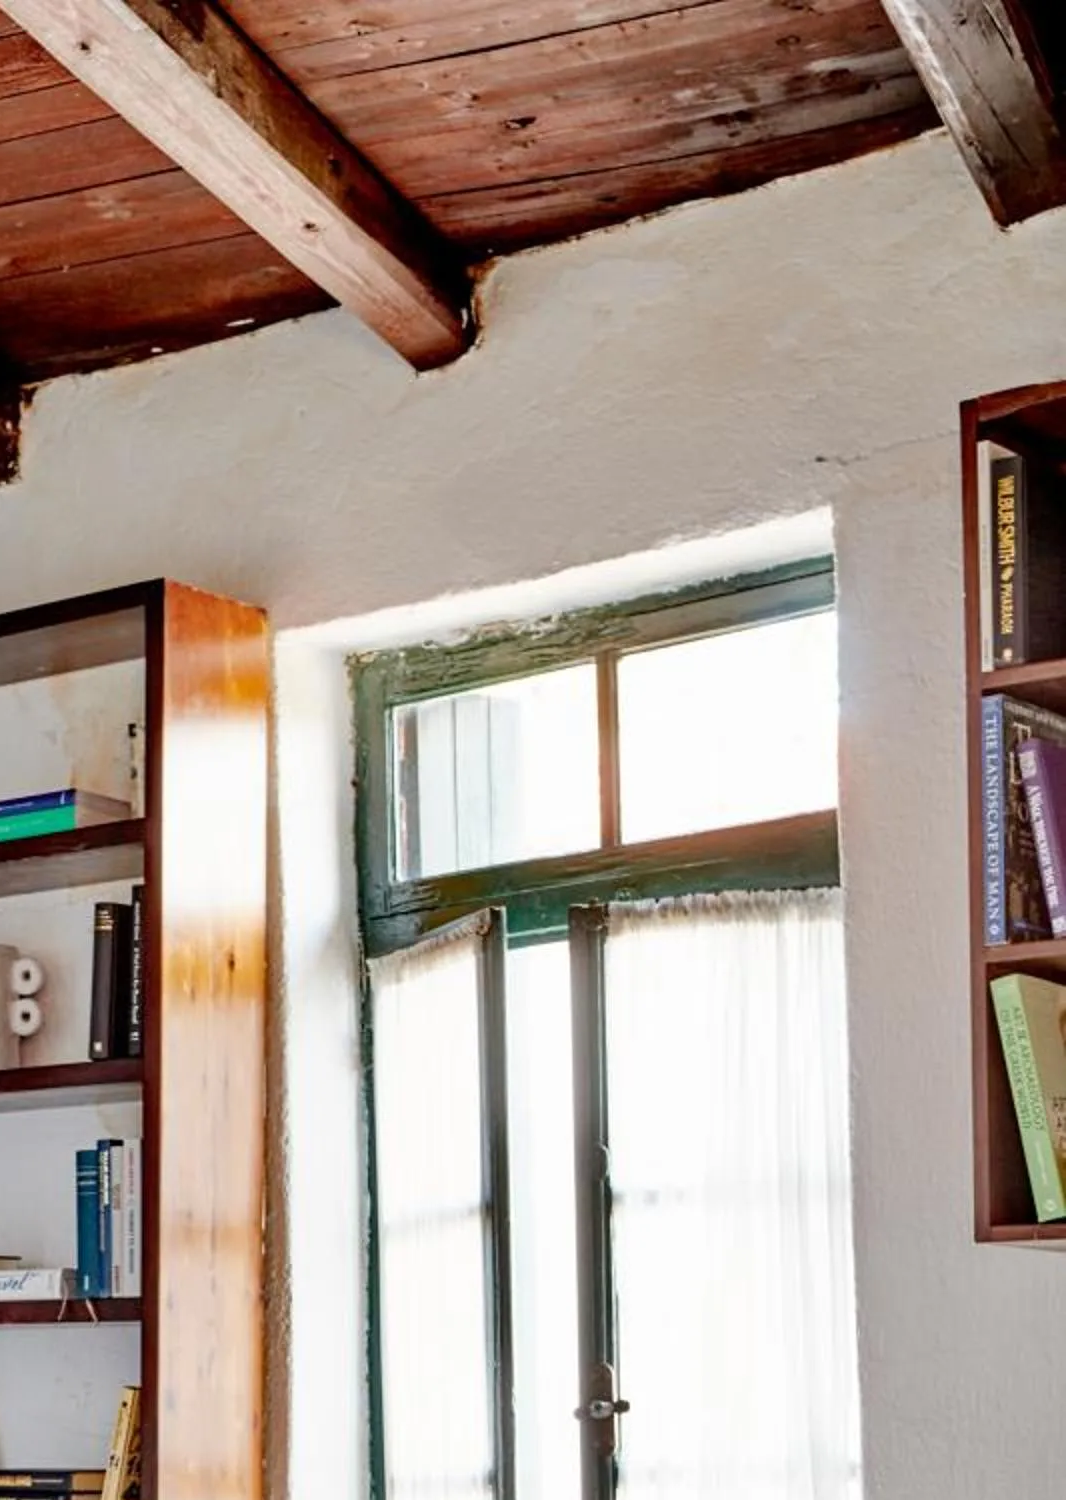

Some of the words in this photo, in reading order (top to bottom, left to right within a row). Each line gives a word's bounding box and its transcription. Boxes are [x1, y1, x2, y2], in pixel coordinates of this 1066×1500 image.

[997, 475, 1015, 526] WILBUR
[998, 526, 1015, 566] SMITH
[985, 716, 998, 750] THE
[985, 754, 999, 852] LANDSCAPE
[986, 853, 999, 876] OF
[987, 880, 1000, 920] MAN
